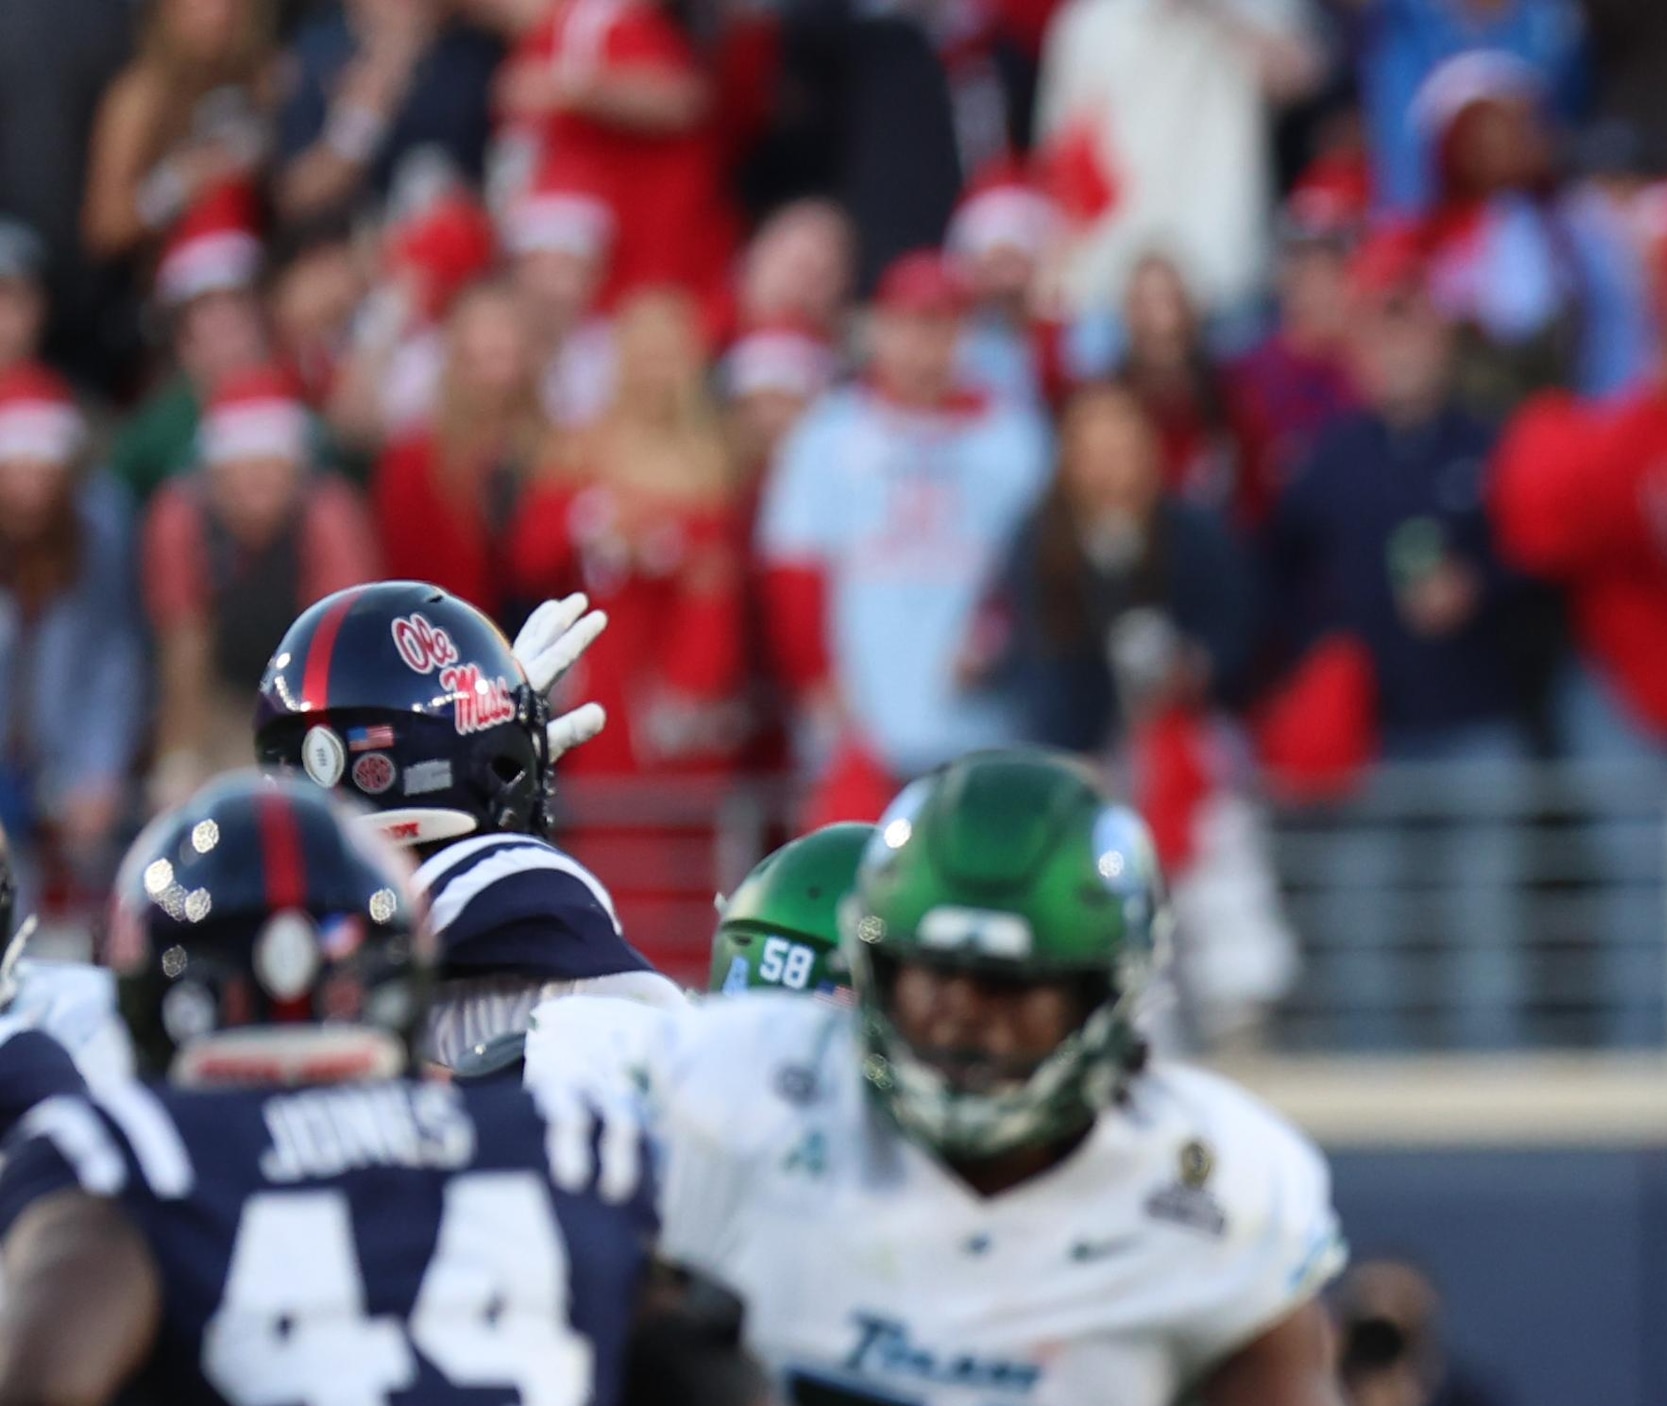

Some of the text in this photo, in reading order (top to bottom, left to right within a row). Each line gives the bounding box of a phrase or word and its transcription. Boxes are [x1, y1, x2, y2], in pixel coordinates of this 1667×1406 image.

[391, 613, 515, 735] Ole Miss
[759, 935, 815, 990] 58
